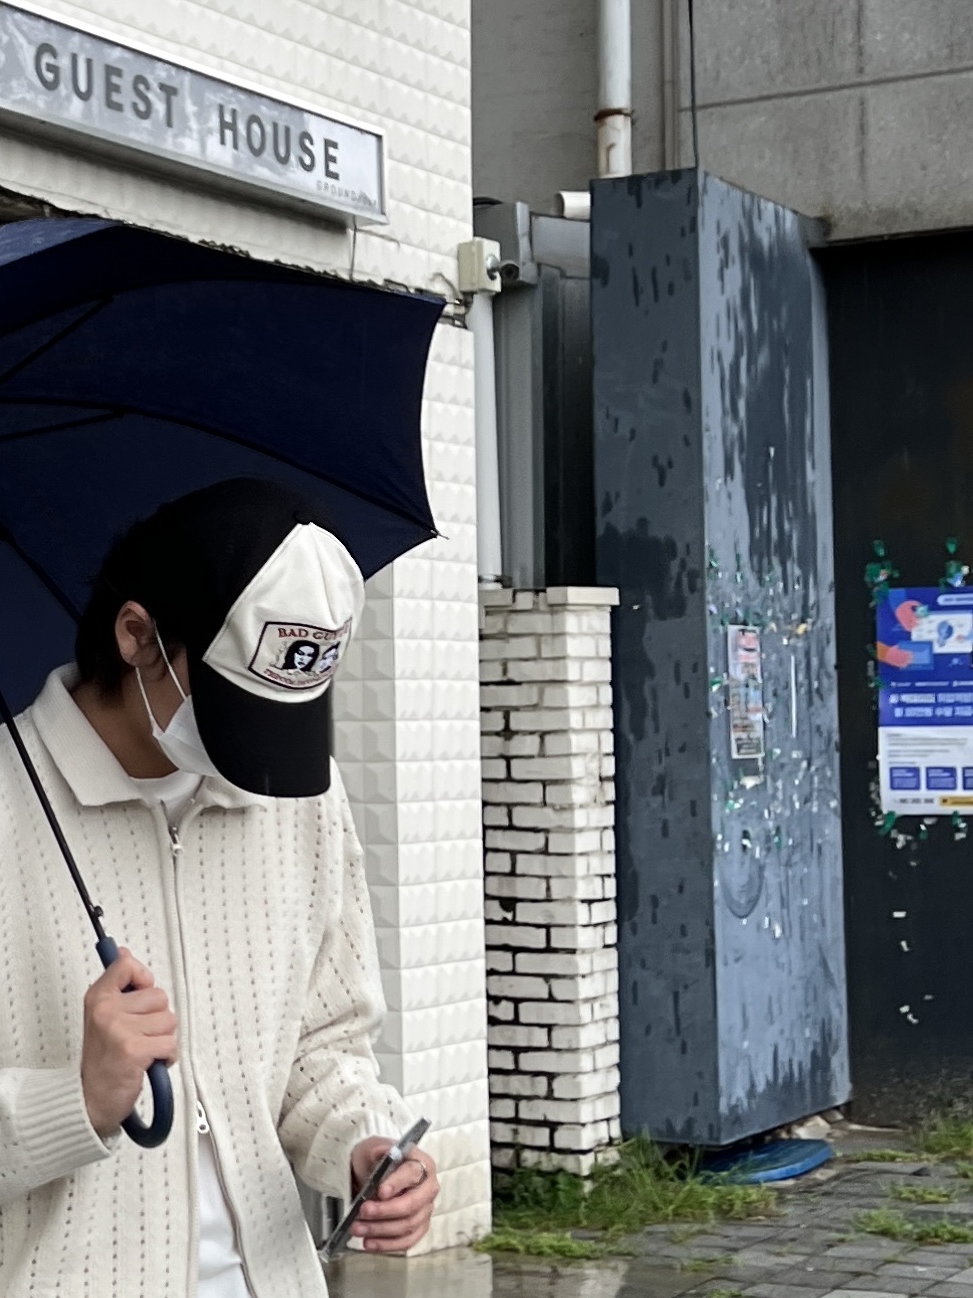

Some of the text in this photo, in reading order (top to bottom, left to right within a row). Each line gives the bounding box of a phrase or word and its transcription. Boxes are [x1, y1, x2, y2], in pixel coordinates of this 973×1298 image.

[34, 42, 340, 181] GUEST HOUSE
[278, 627, 309, 638] BAD
